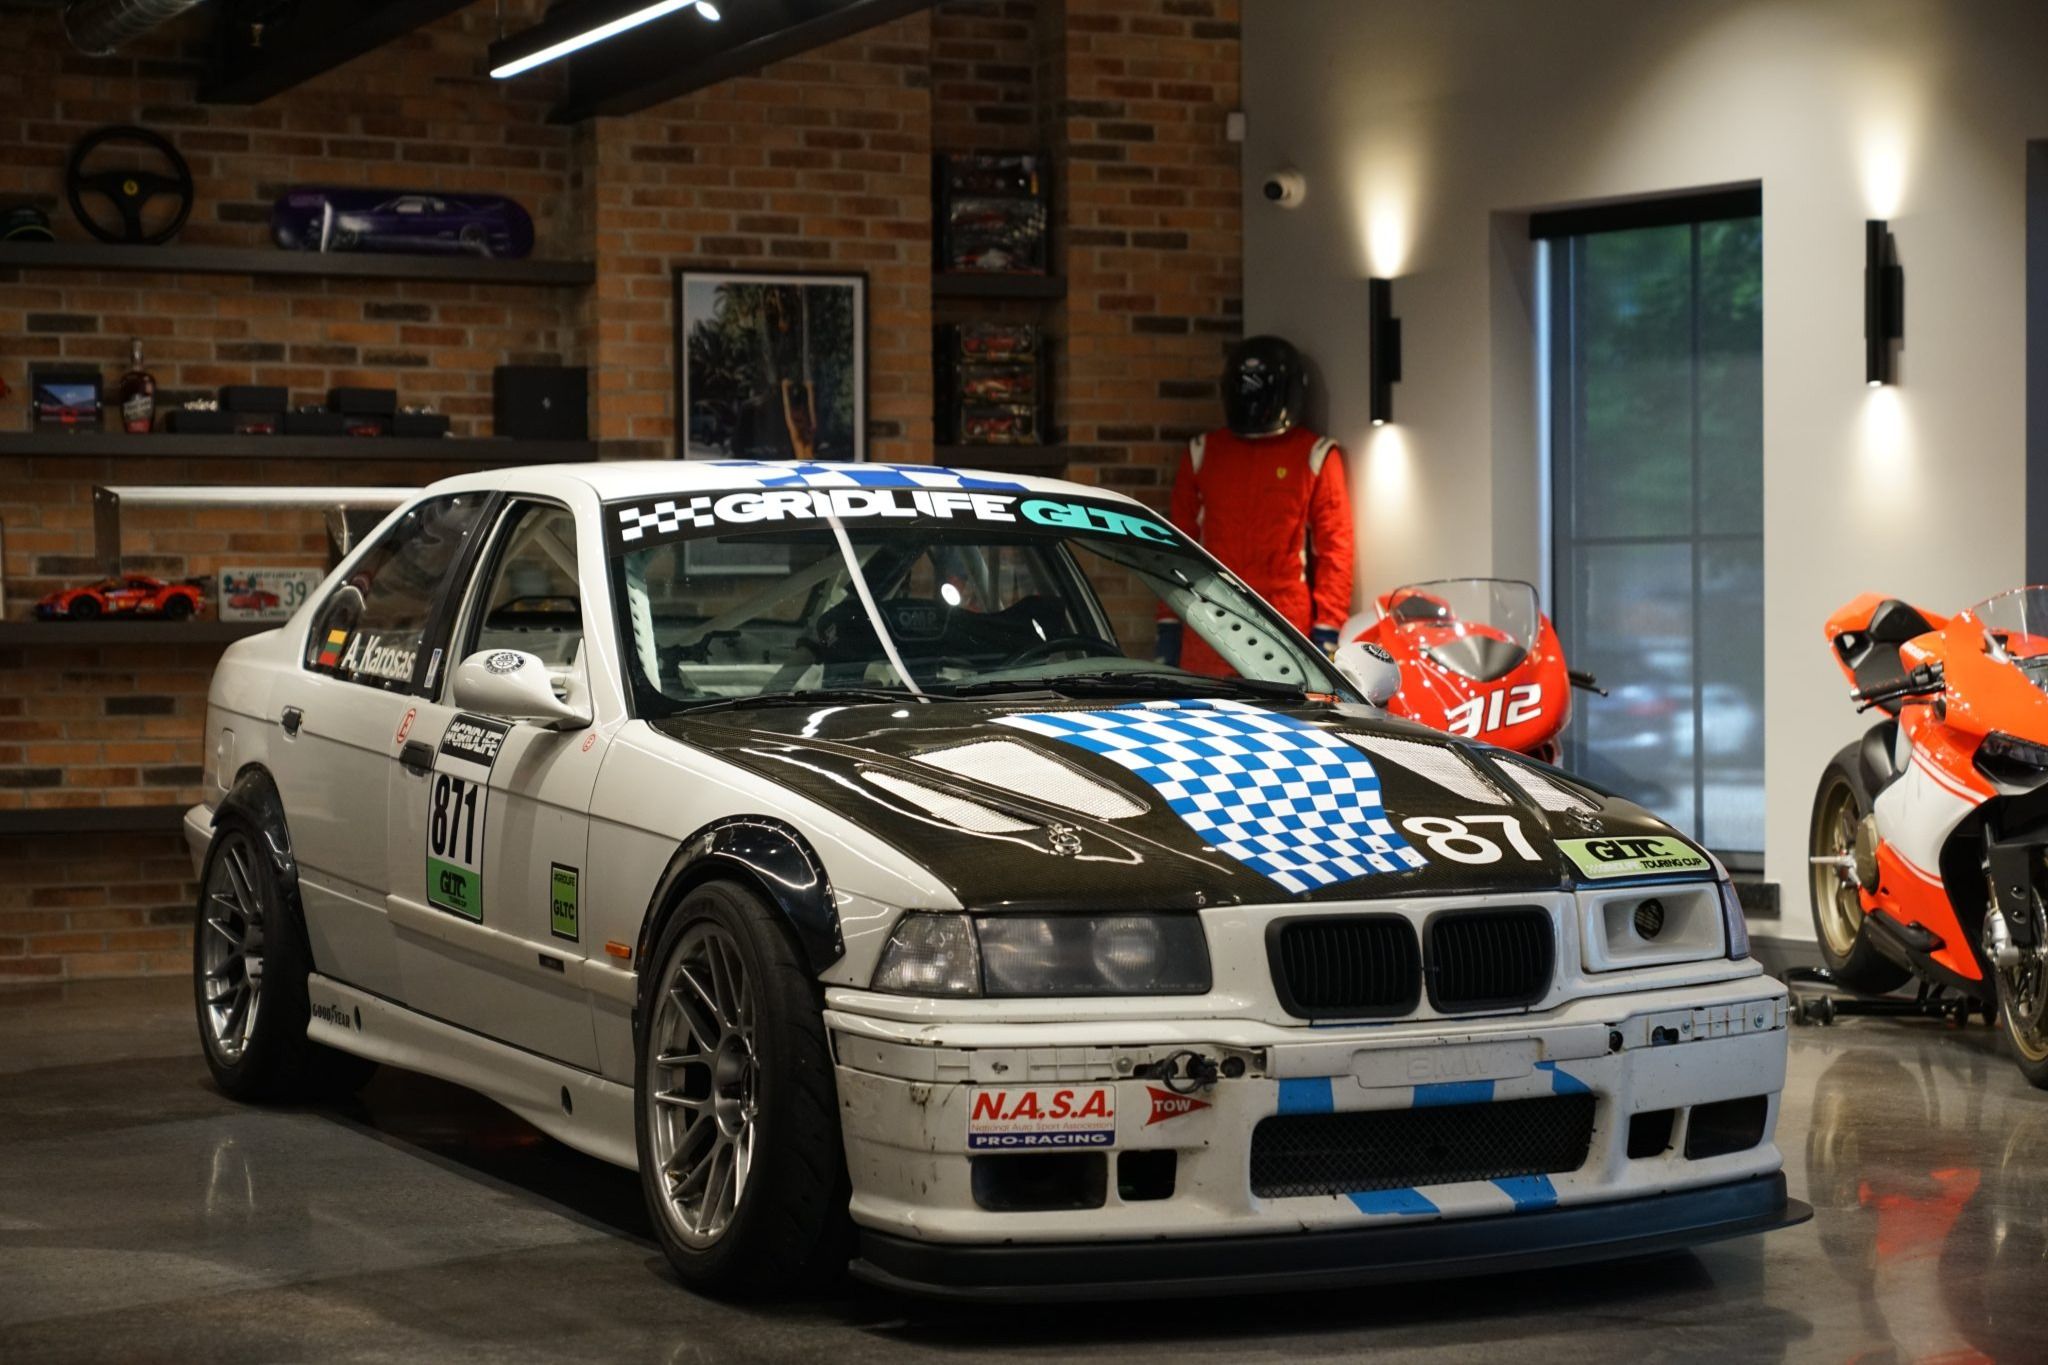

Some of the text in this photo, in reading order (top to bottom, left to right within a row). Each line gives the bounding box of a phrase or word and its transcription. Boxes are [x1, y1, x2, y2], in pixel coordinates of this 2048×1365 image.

[714, 489, 1180, 548] GRIDLIFE GLTC
[340, 632, 361, 672] A.
[359, 634, 416, 680] Karosas
[1444, 683, 1542, 739] 312
[431, 774, 479, 865] 871
[1402, 815, 1543, 865] 87
[1585, 838, 1675, 862] GLTC
[1641, 857, 1683, 870] TOURING
[1683, 857, 1702, 867] CUP
[440, 869, 467, 899] GLTC
[553, 898, 575, 920] GLTC
[972, 1089, 1114, 1121] N.A.S.A.
[1153, 1099, 1191, 1113] TOW
[972, 1120, 1113, 1133] National Auto Sport Association
[976, 1133, 1107, 1146] PRO-RACING
